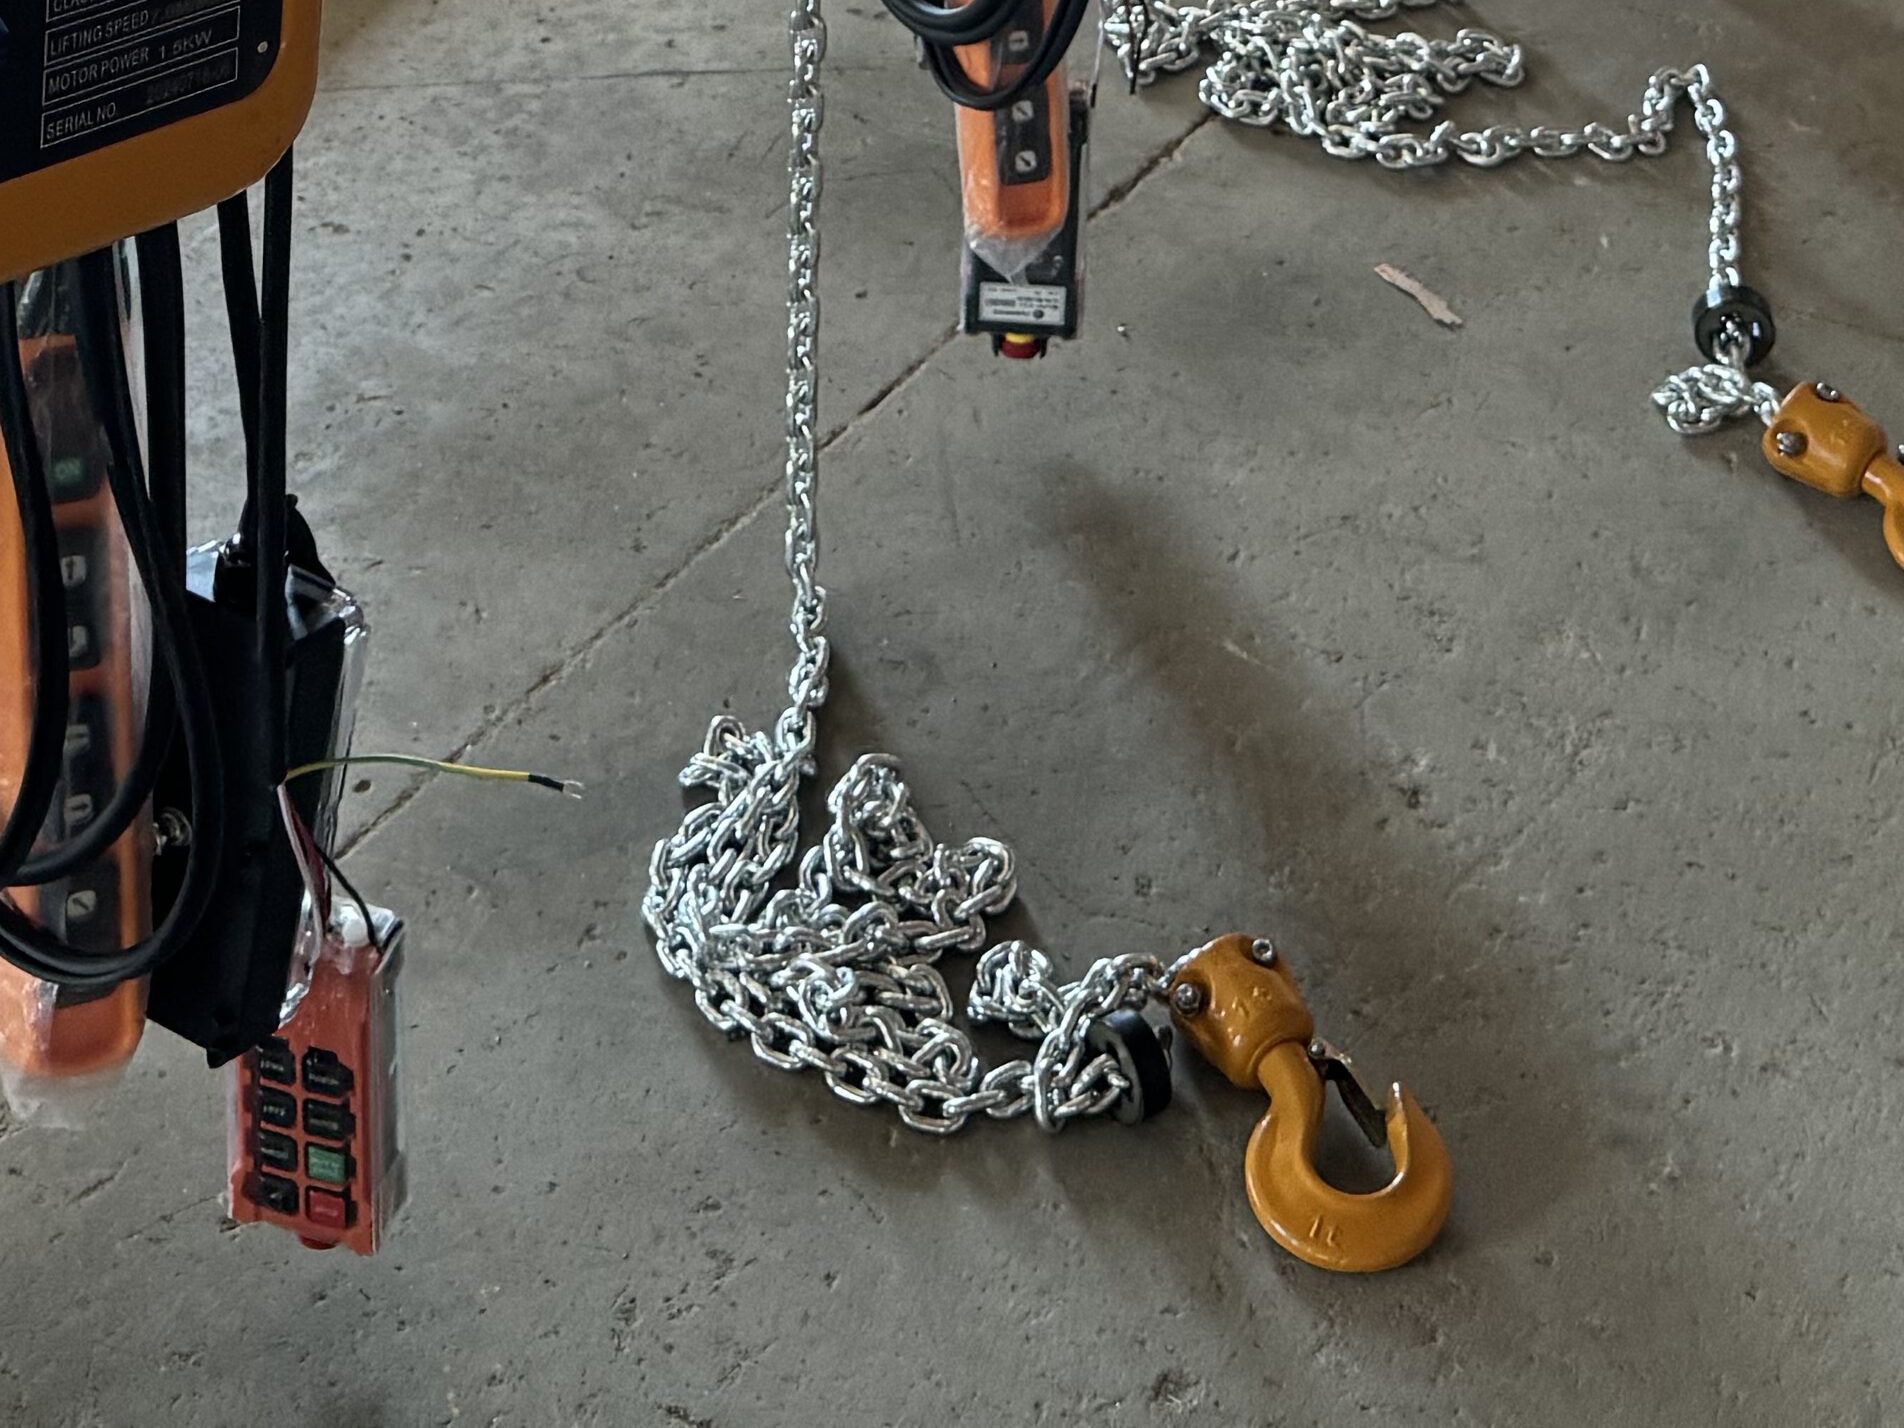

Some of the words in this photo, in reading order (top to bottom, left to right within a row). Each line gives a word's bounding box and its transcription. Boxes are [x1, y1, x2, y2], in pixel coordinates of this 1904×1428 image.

[50, 24, 103, 57] LIFTING
[105, 8, 150, 39] SPEED
[47, 64, 98, 95] MOTOR
[100, 46, 150, 77] POWER
[45, 110, 95, 140] SERIAL
